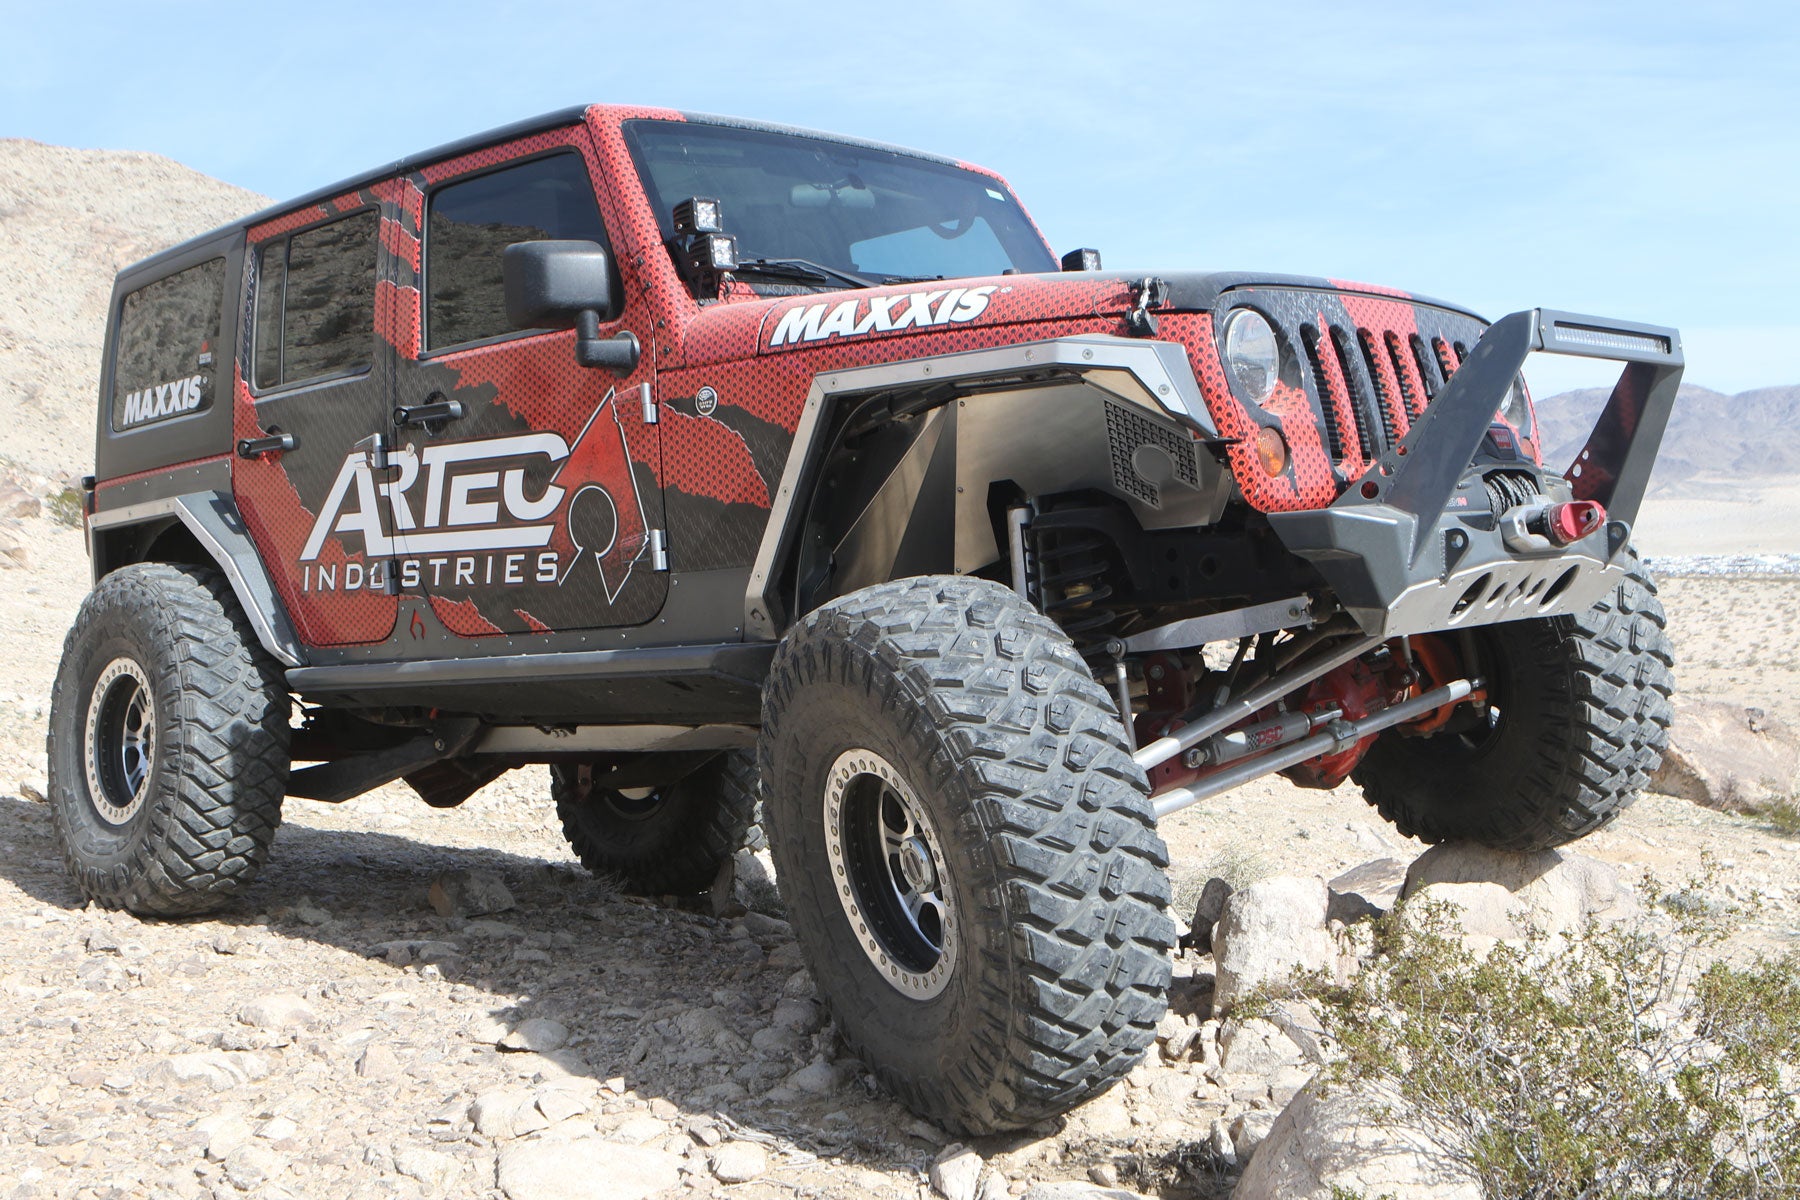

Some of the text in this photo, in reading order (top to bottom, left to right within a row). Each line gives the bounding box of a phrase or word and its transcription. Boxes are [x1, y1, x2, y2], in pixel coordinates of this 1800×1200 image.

[769, 285, 999, 346] MAXXIS
[122, 375, 202, 425] MAXXIS
[299, 432, 570, 561] ARTEC
[1256, 725, 1284, 745] PSC
